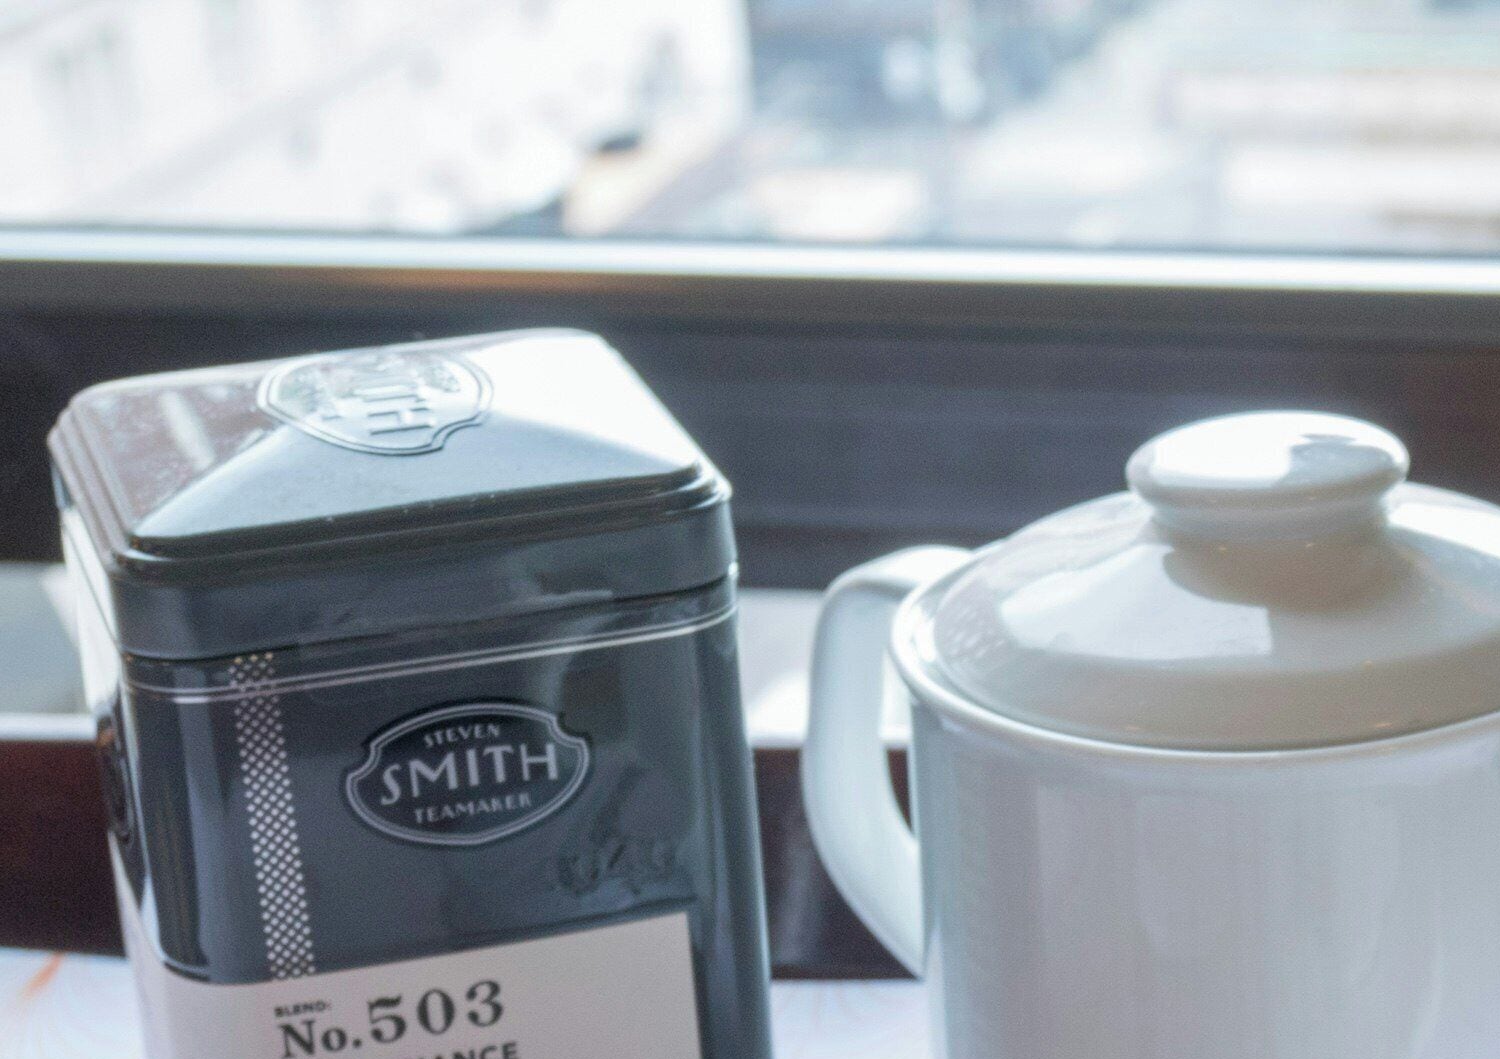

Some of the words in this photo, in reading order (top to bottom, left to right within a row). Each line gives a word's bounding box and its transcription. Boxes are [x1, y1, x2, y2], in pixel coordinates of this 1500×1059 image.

[424, 722, 500, 749] STEVEN
[380, 742, 559, 806] SMITH
[414, 793, 532, 825] TEAMAKER
